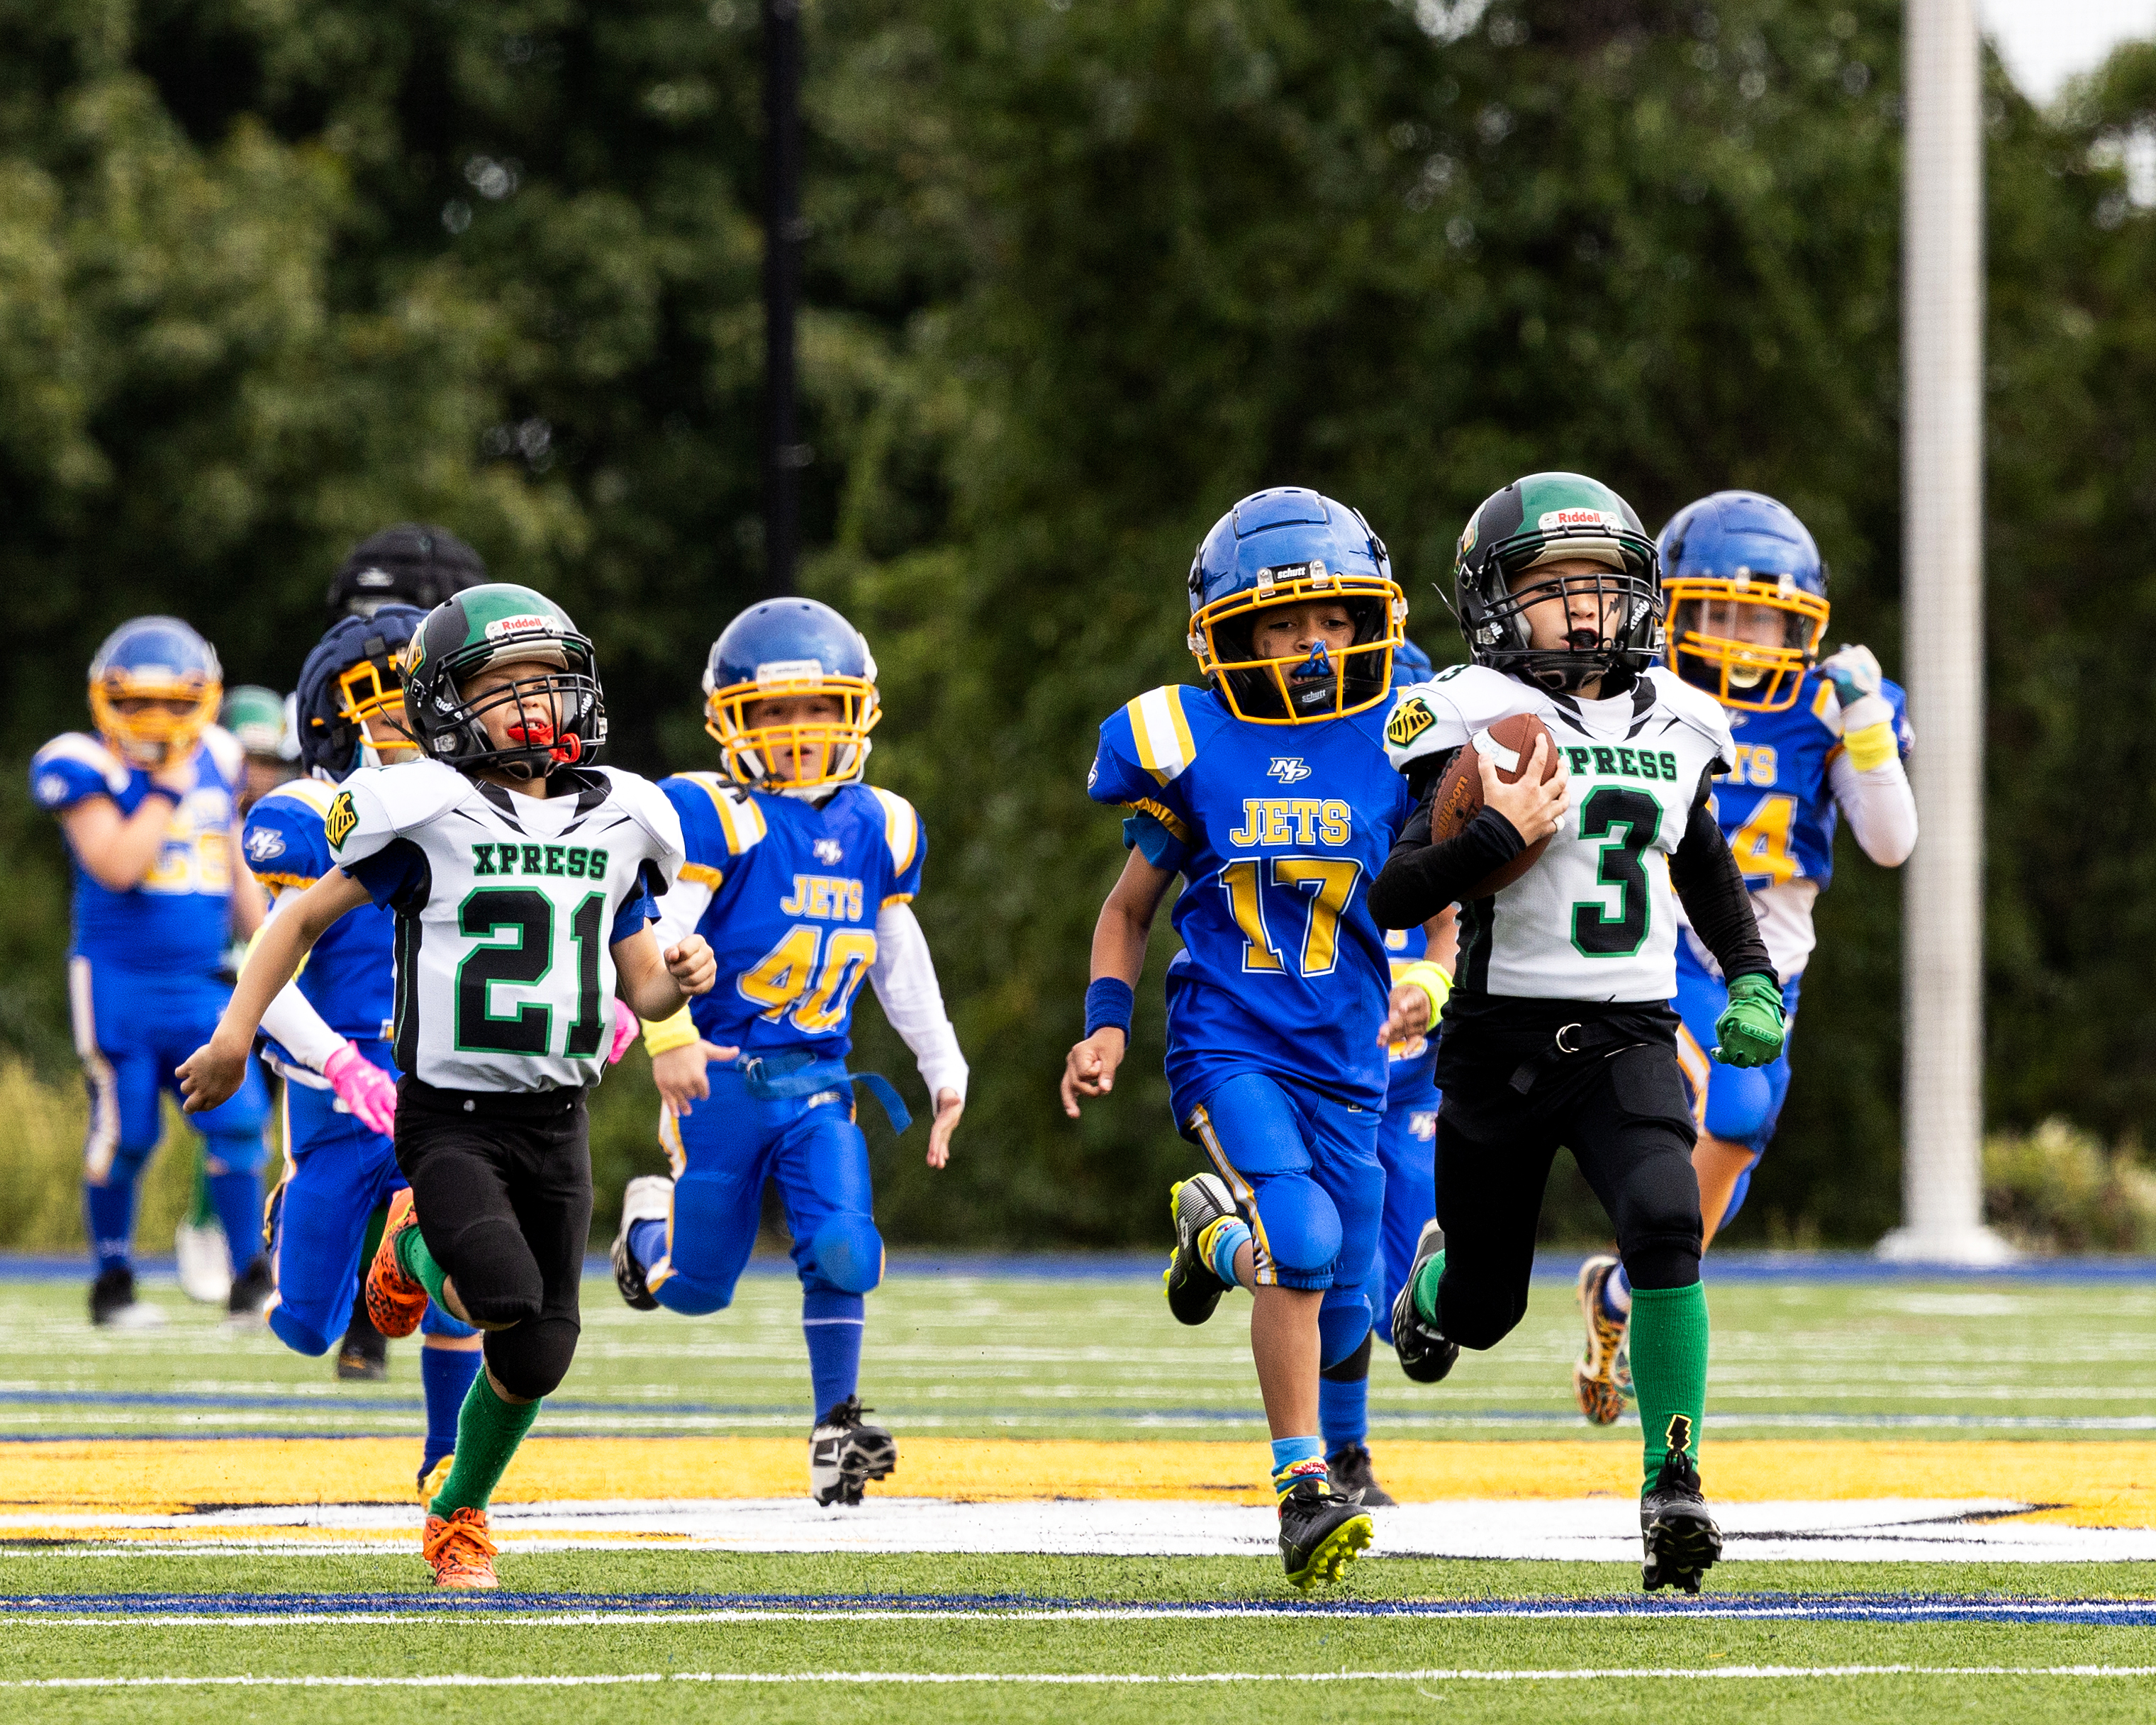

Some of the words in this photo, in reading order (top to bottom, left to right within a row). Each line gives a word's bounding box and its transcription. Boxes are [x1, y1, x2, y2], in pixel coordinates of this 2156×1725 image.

[1558, 511, 1602, 524] Riddell
[1277, 566, 1306, 579] schutt
[501, 618, 543, 631] Riddell
[1624, 599, 1650, 630] Ridd
[1302, 688, 1326, 703] schutt
[1557, 745, 1678, 783] PRESS
[1710, 742, 1779, 788] TS
[1229, 798, 1351, 847] JETS
[472, 843, 610, 881] XPRESS
[1570, 784, 1664, 959] 3
[781, 873, 864, 922] JETS
[1218, 854, 1364, 978] 17
[453, 886, 607, 1059] 21
[737, 924, 877, 1034] 40
